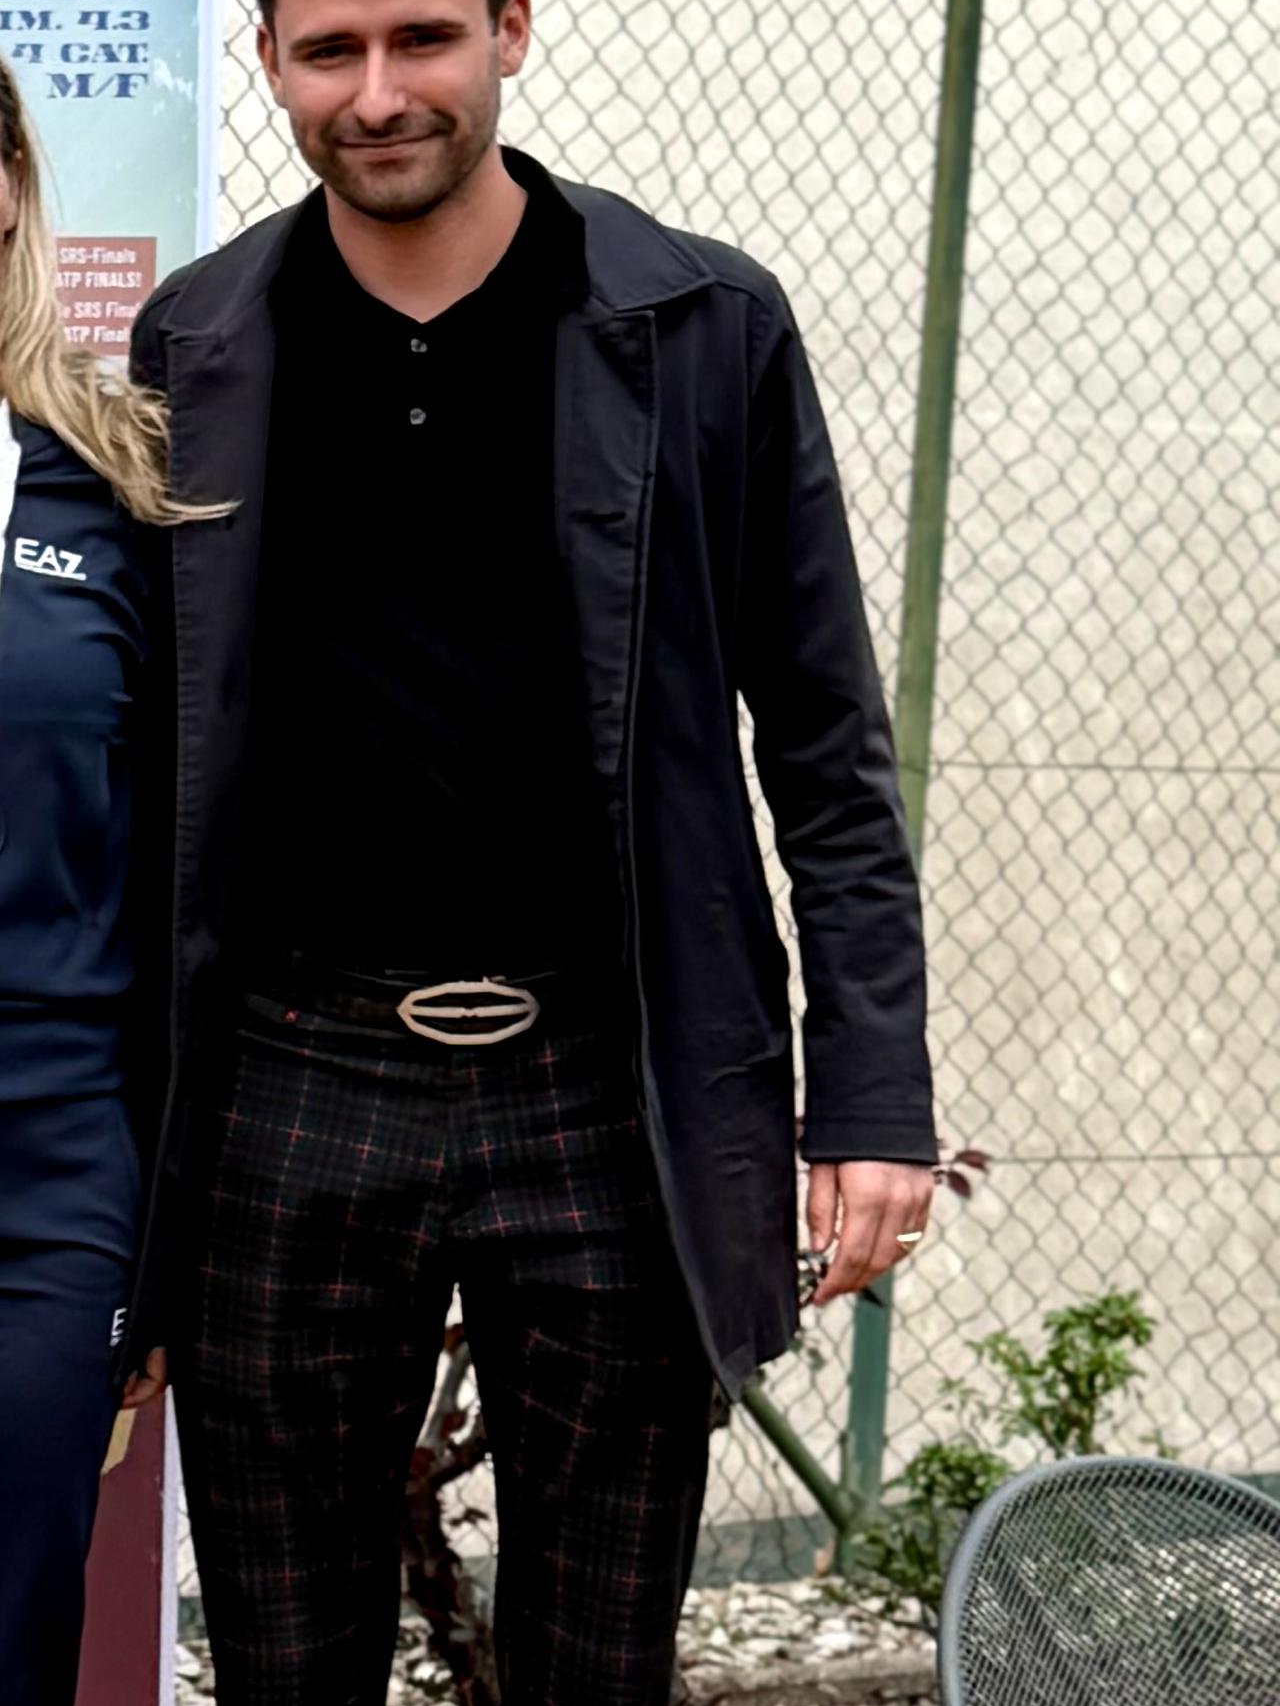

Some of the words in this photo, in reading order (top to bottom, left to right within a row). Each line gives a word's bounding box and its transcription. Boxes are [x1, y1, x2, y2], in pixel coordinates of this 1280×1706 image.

[77, 10, 151, 31] 4.3
[59, 42, 149, 64] CAT.
[45, 72, 151, 99] M/F
[14, 537, 85, 576] EA7
